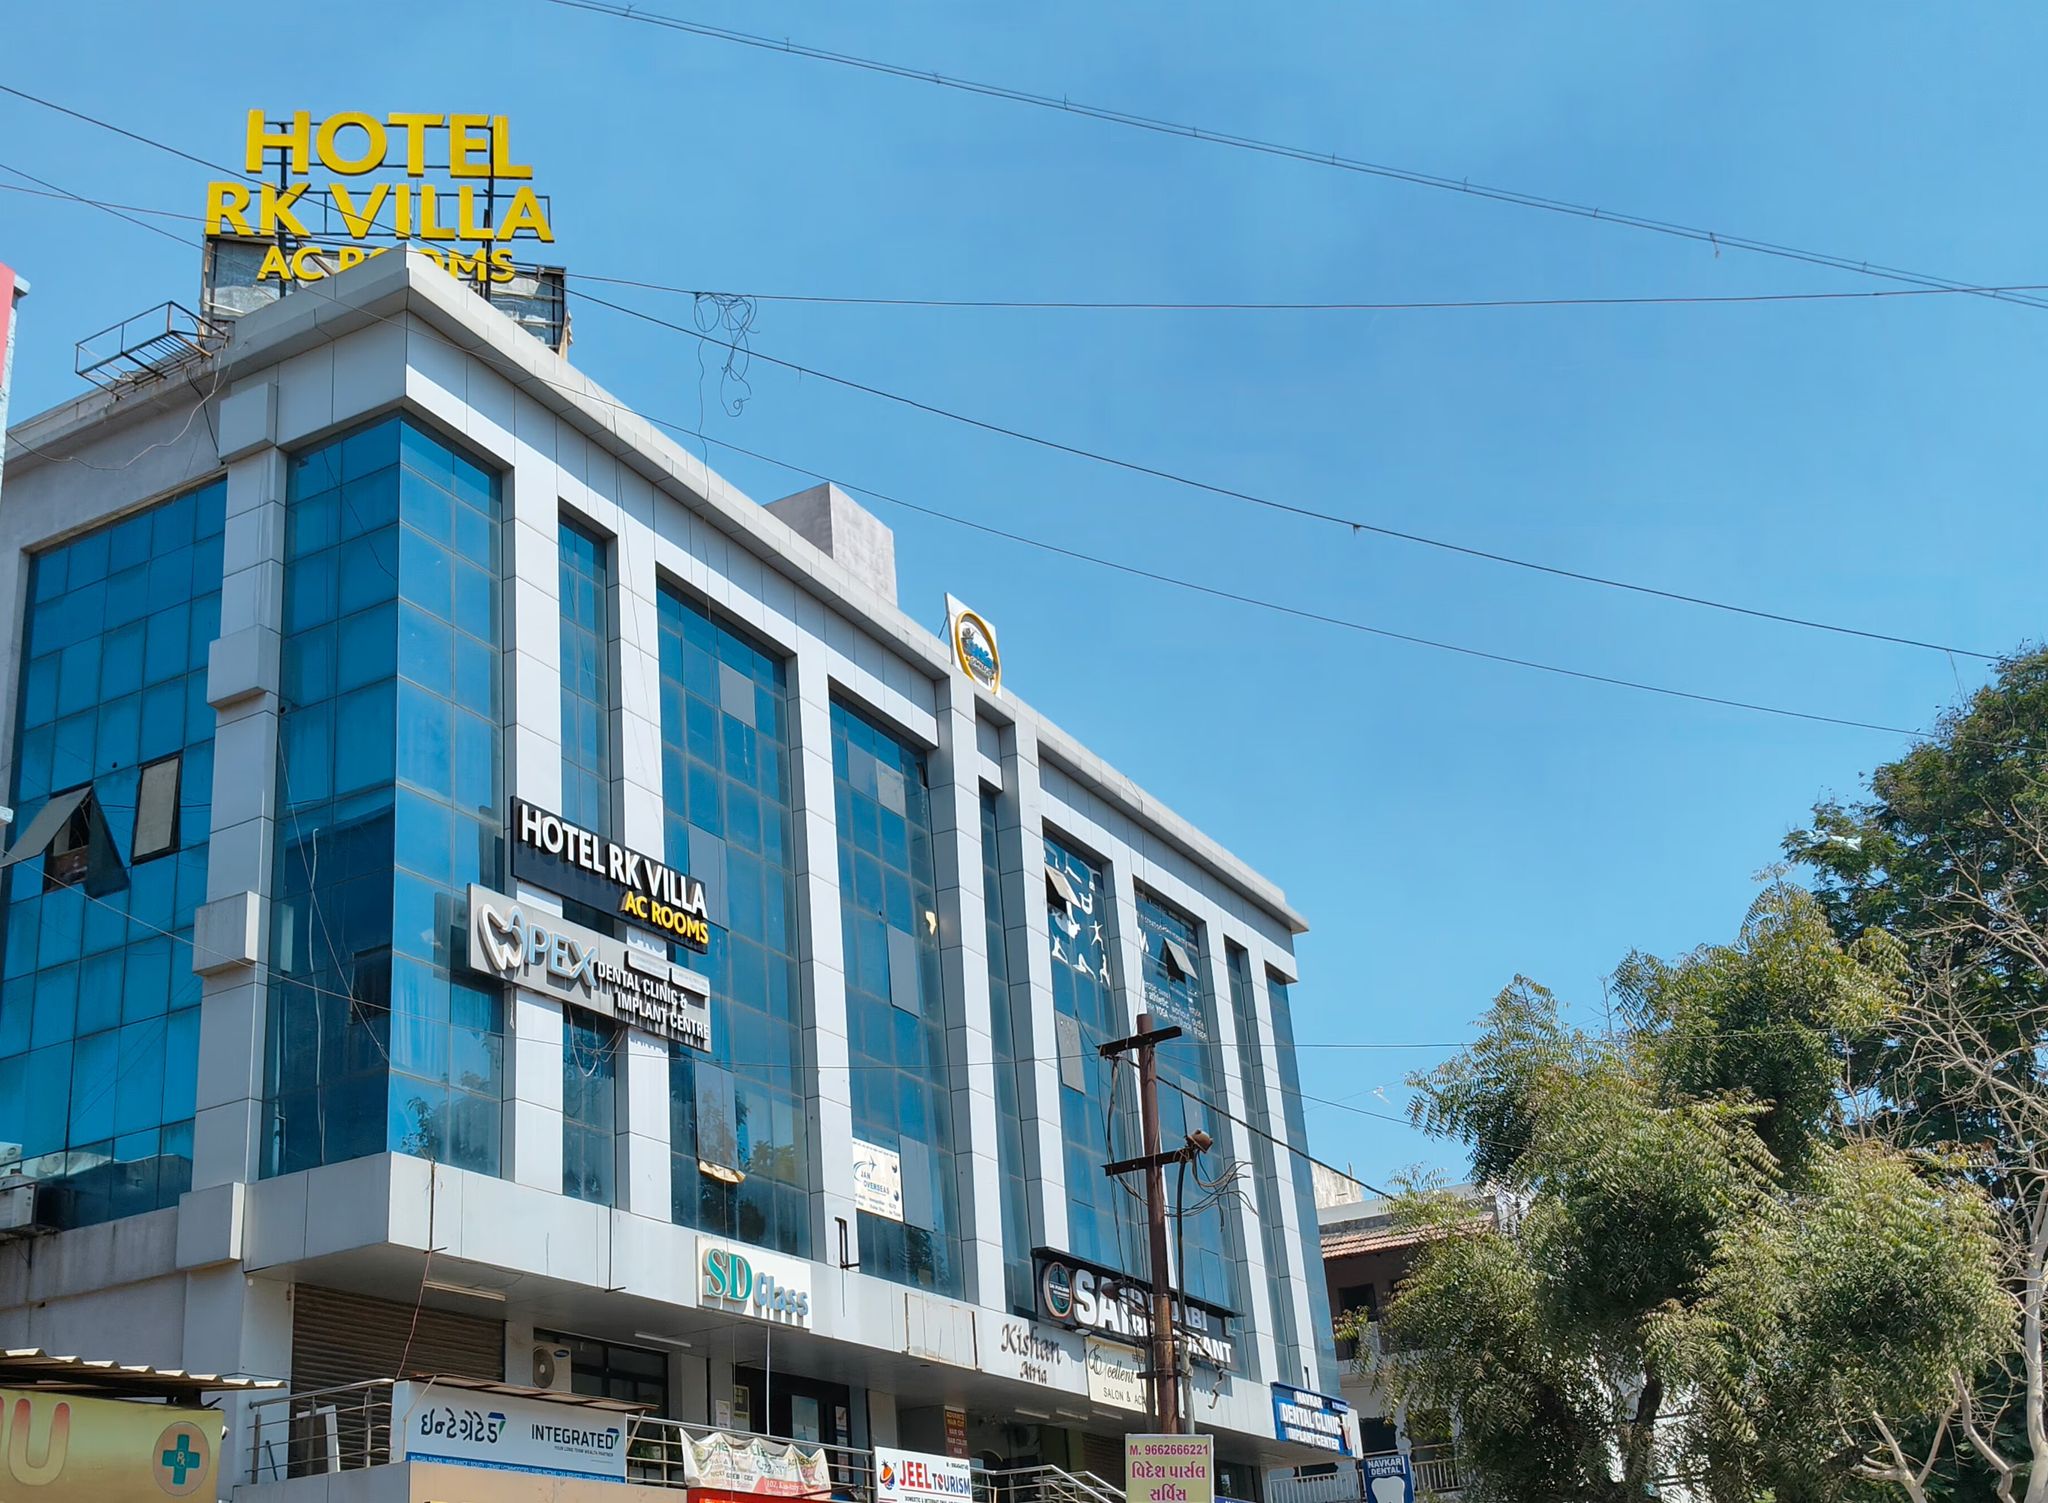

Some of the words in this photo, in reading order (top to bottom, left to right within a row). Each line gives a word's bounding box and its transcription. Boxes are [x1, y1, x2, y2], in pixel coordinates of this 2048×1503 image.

[246, 109, 533, 179] HOTEL
[205, 182, 311, 237] RK
[329, 184, 555, 243] VILLA
[257, 246, 325, 281] AC
[340, 247, 515, 283] RMS
[521, 804, 606, 874] HOTEL
[609, 843, 642, 890] RK
[644, 859, 708, 920] VILLA
[622, 891, 648, 918] AC
[651, 900, 710, 944] ROOMS
[597, 961, 641, 992] DENTAL
[643, 979, 678, 1006] CLINIC
[680, 993, 688, 1009] &
[617, 992, 667, 1024] IMPLANT
[670, 1011, 710, 1040] CENTRE
[703, 1248, 753, 1301] SD
[753, 1271, 809, 1317] Class
[1074, 1269, 1130, 1335] SAI
[1103, 1387, 1124, 1402] SALON
[532, 1424, 614, 1450] INTEGRATED
[1280, 1403, 1315, 1428] DENTAL
[1312, 1411, 1342, 1435] CLINIC
[1129, 1445, 1141, 1455] M.
[1145, 1444, 1208, 1455] 9662666221
[1367, 1458, 1402, 1468] NAVKAR
[900, 1460, 932, 1489] JEEL
[932, 1472, 970, 1495] TOURISM
[1132, 1461, 1166, 1478] વિદેશ
[1169, 1461, 1206, 1478] પાર્સલ
[1371, 1466, 1401, 1476] DENTAL
